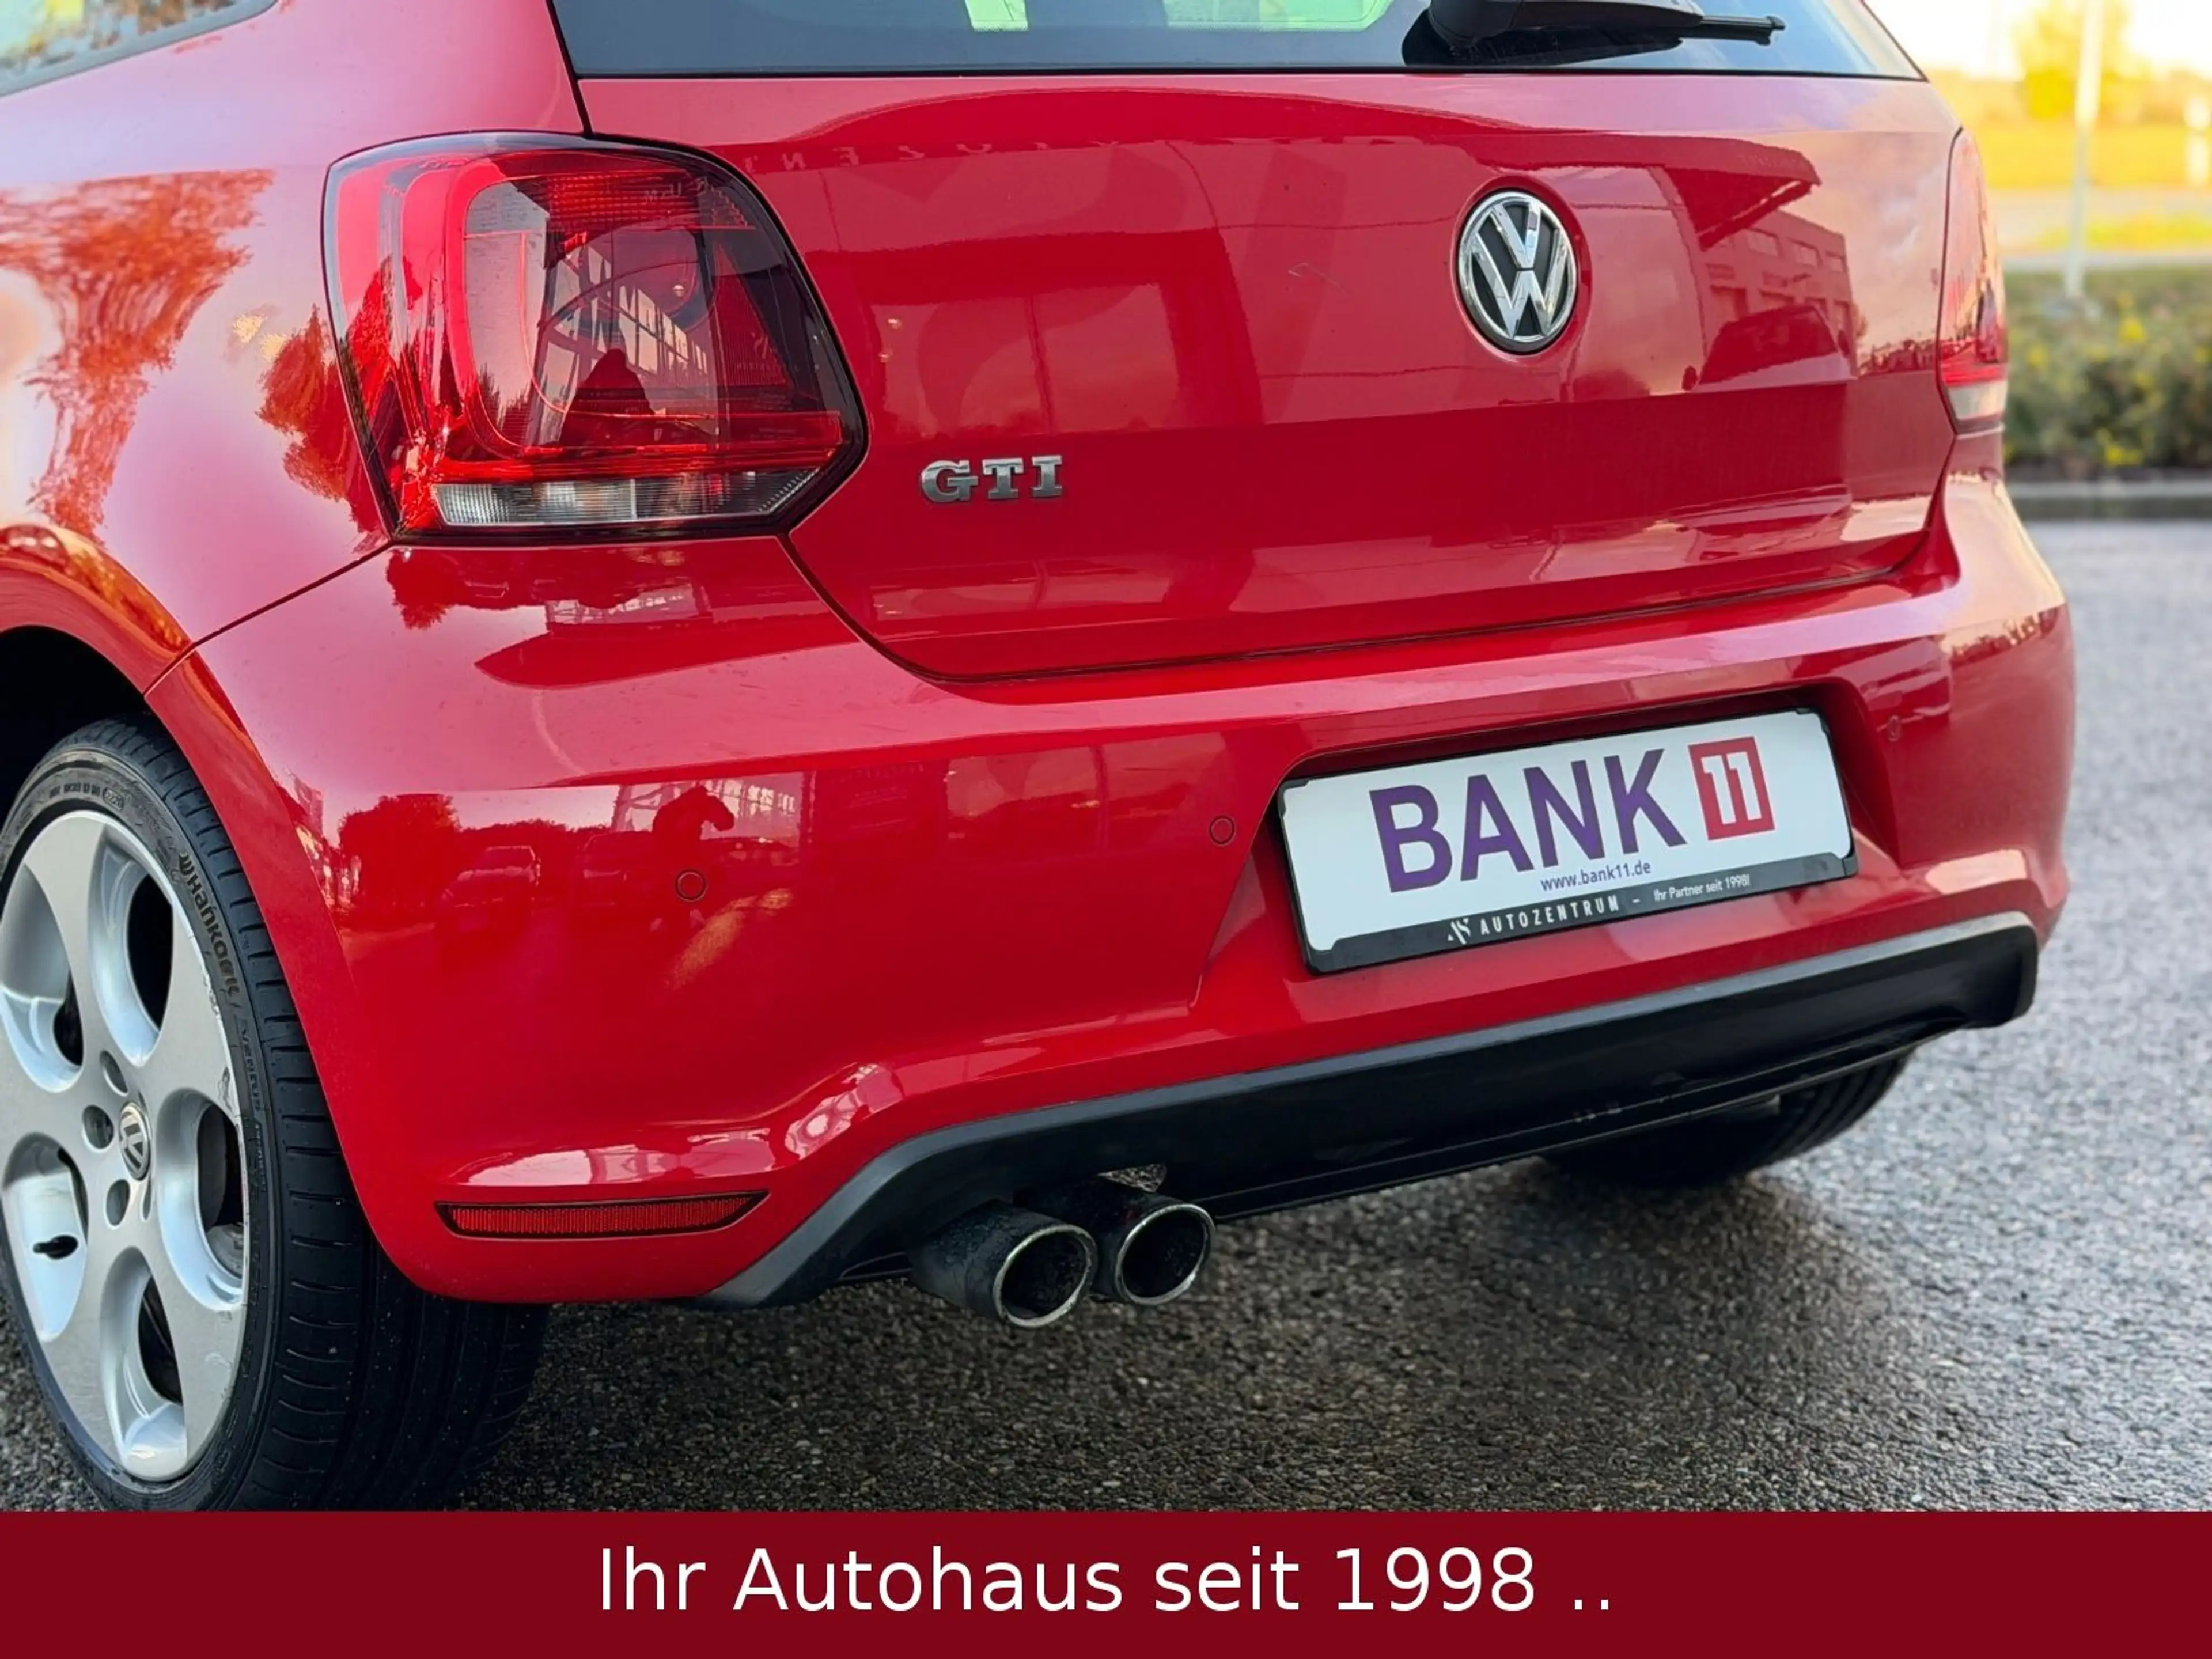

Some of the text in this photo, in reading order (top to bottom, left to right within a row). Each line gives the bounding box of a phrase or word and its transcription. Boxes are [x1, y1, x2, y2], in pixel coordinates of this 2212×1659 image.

[921, 454, 1063, 503] GTI
[1369, 749, 1762, 892] BANK 11
[1540, 859, 1652, 891] www.bank11.de
[1480, 895, 1619, 935] AUTOZENTRUM
[1653, 889, 1667, 903] Ihr
[1669, 884, 1703, 899] Partner
[1705, 879, 1723, 893] seit
